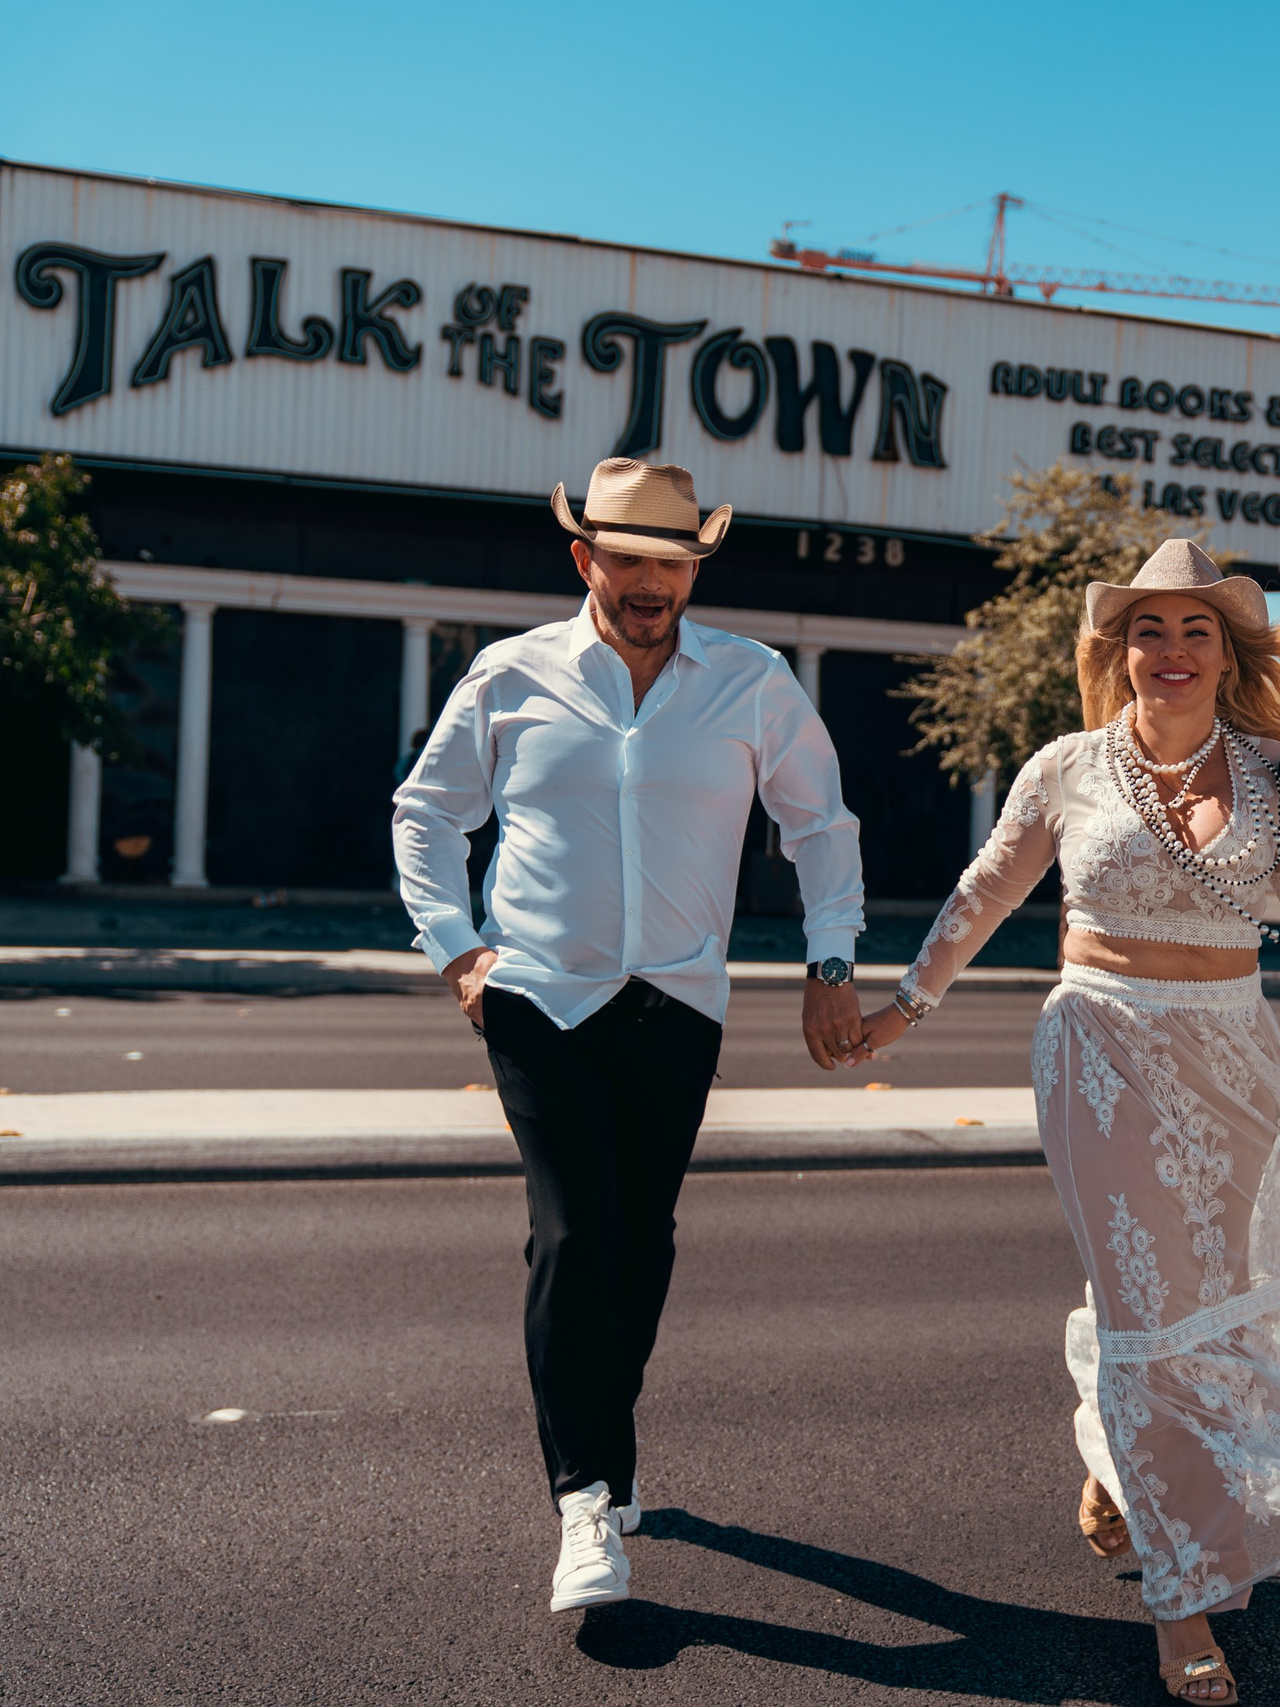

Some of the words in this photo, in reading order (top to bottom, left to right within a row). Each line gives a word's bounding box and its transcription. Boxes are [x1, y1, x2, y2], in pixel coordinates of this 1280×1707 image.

[16, 241, 423, 418] TALK
[453, 281, 530, 330] OF
[441, 324, 566, 420] THE
[582, 311, 950, 469] TOWN
[990, 361, 1108, 406] ADULT
[1118, 376, 1253, 423] BOOKS
[1070, 421, 1160, 463] BEST
[1143, 479, 1207, 517] LAS
